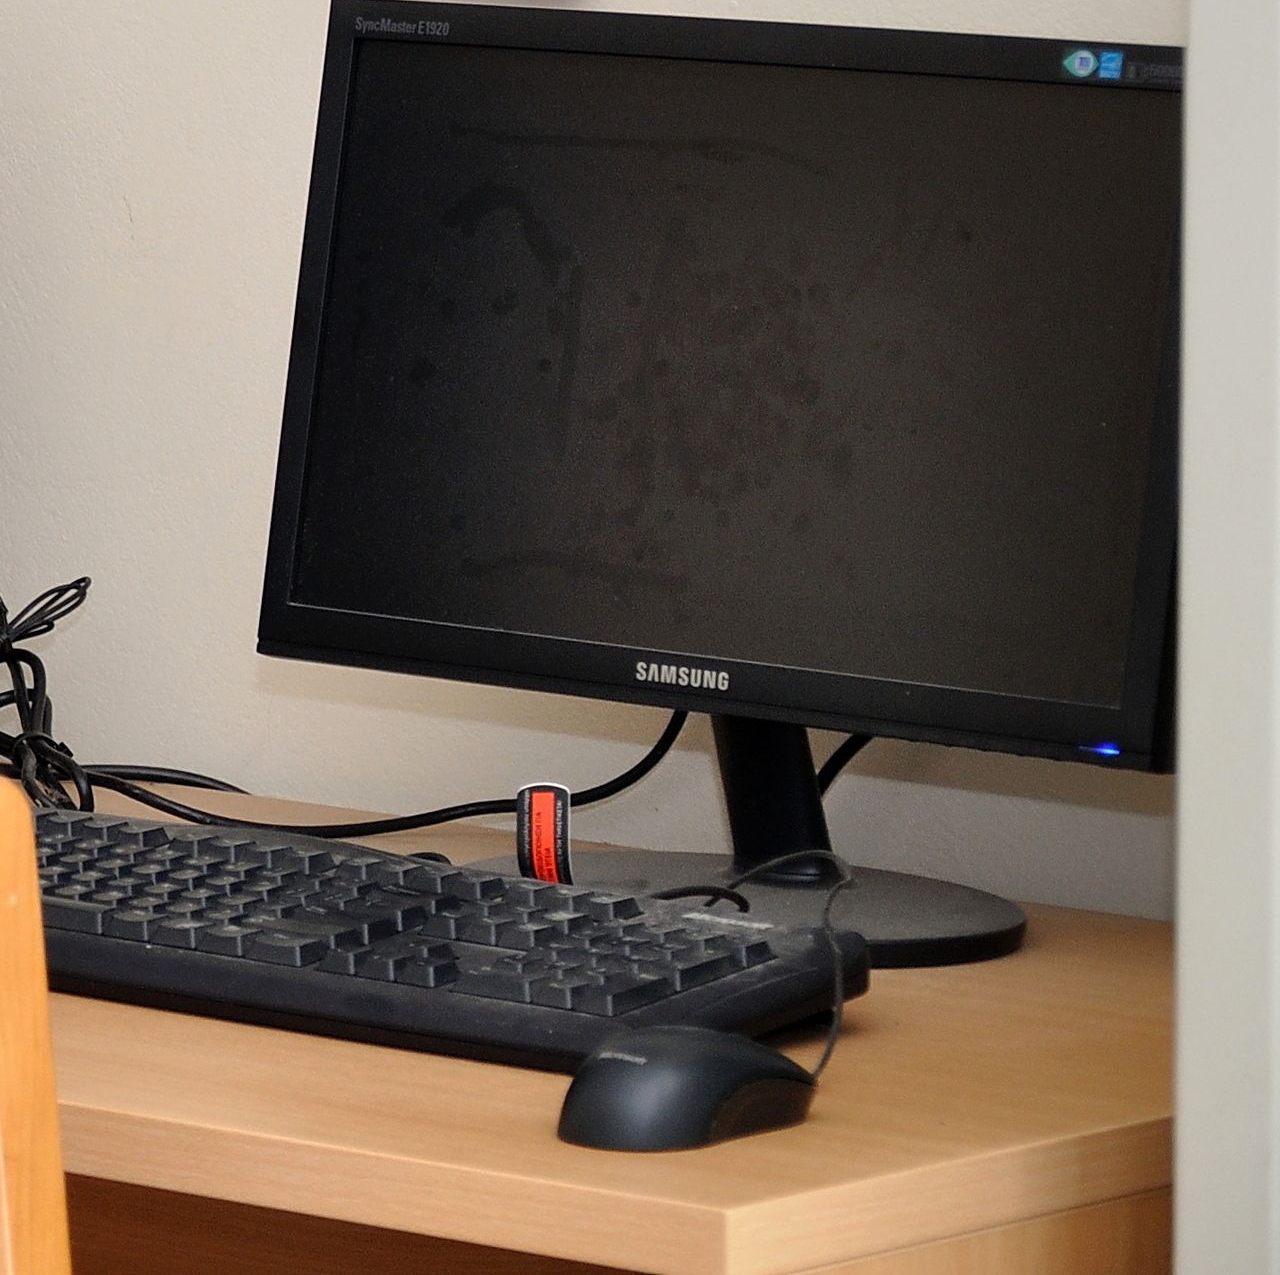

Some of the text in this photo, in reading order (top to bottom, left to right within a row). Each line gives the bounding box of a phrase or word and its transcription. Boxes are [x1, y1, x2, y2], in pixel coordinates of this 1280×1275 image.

[355, 16, 449, 36] SyncMaster E1920
[635, 661, 730, 691] SAMSUNG
